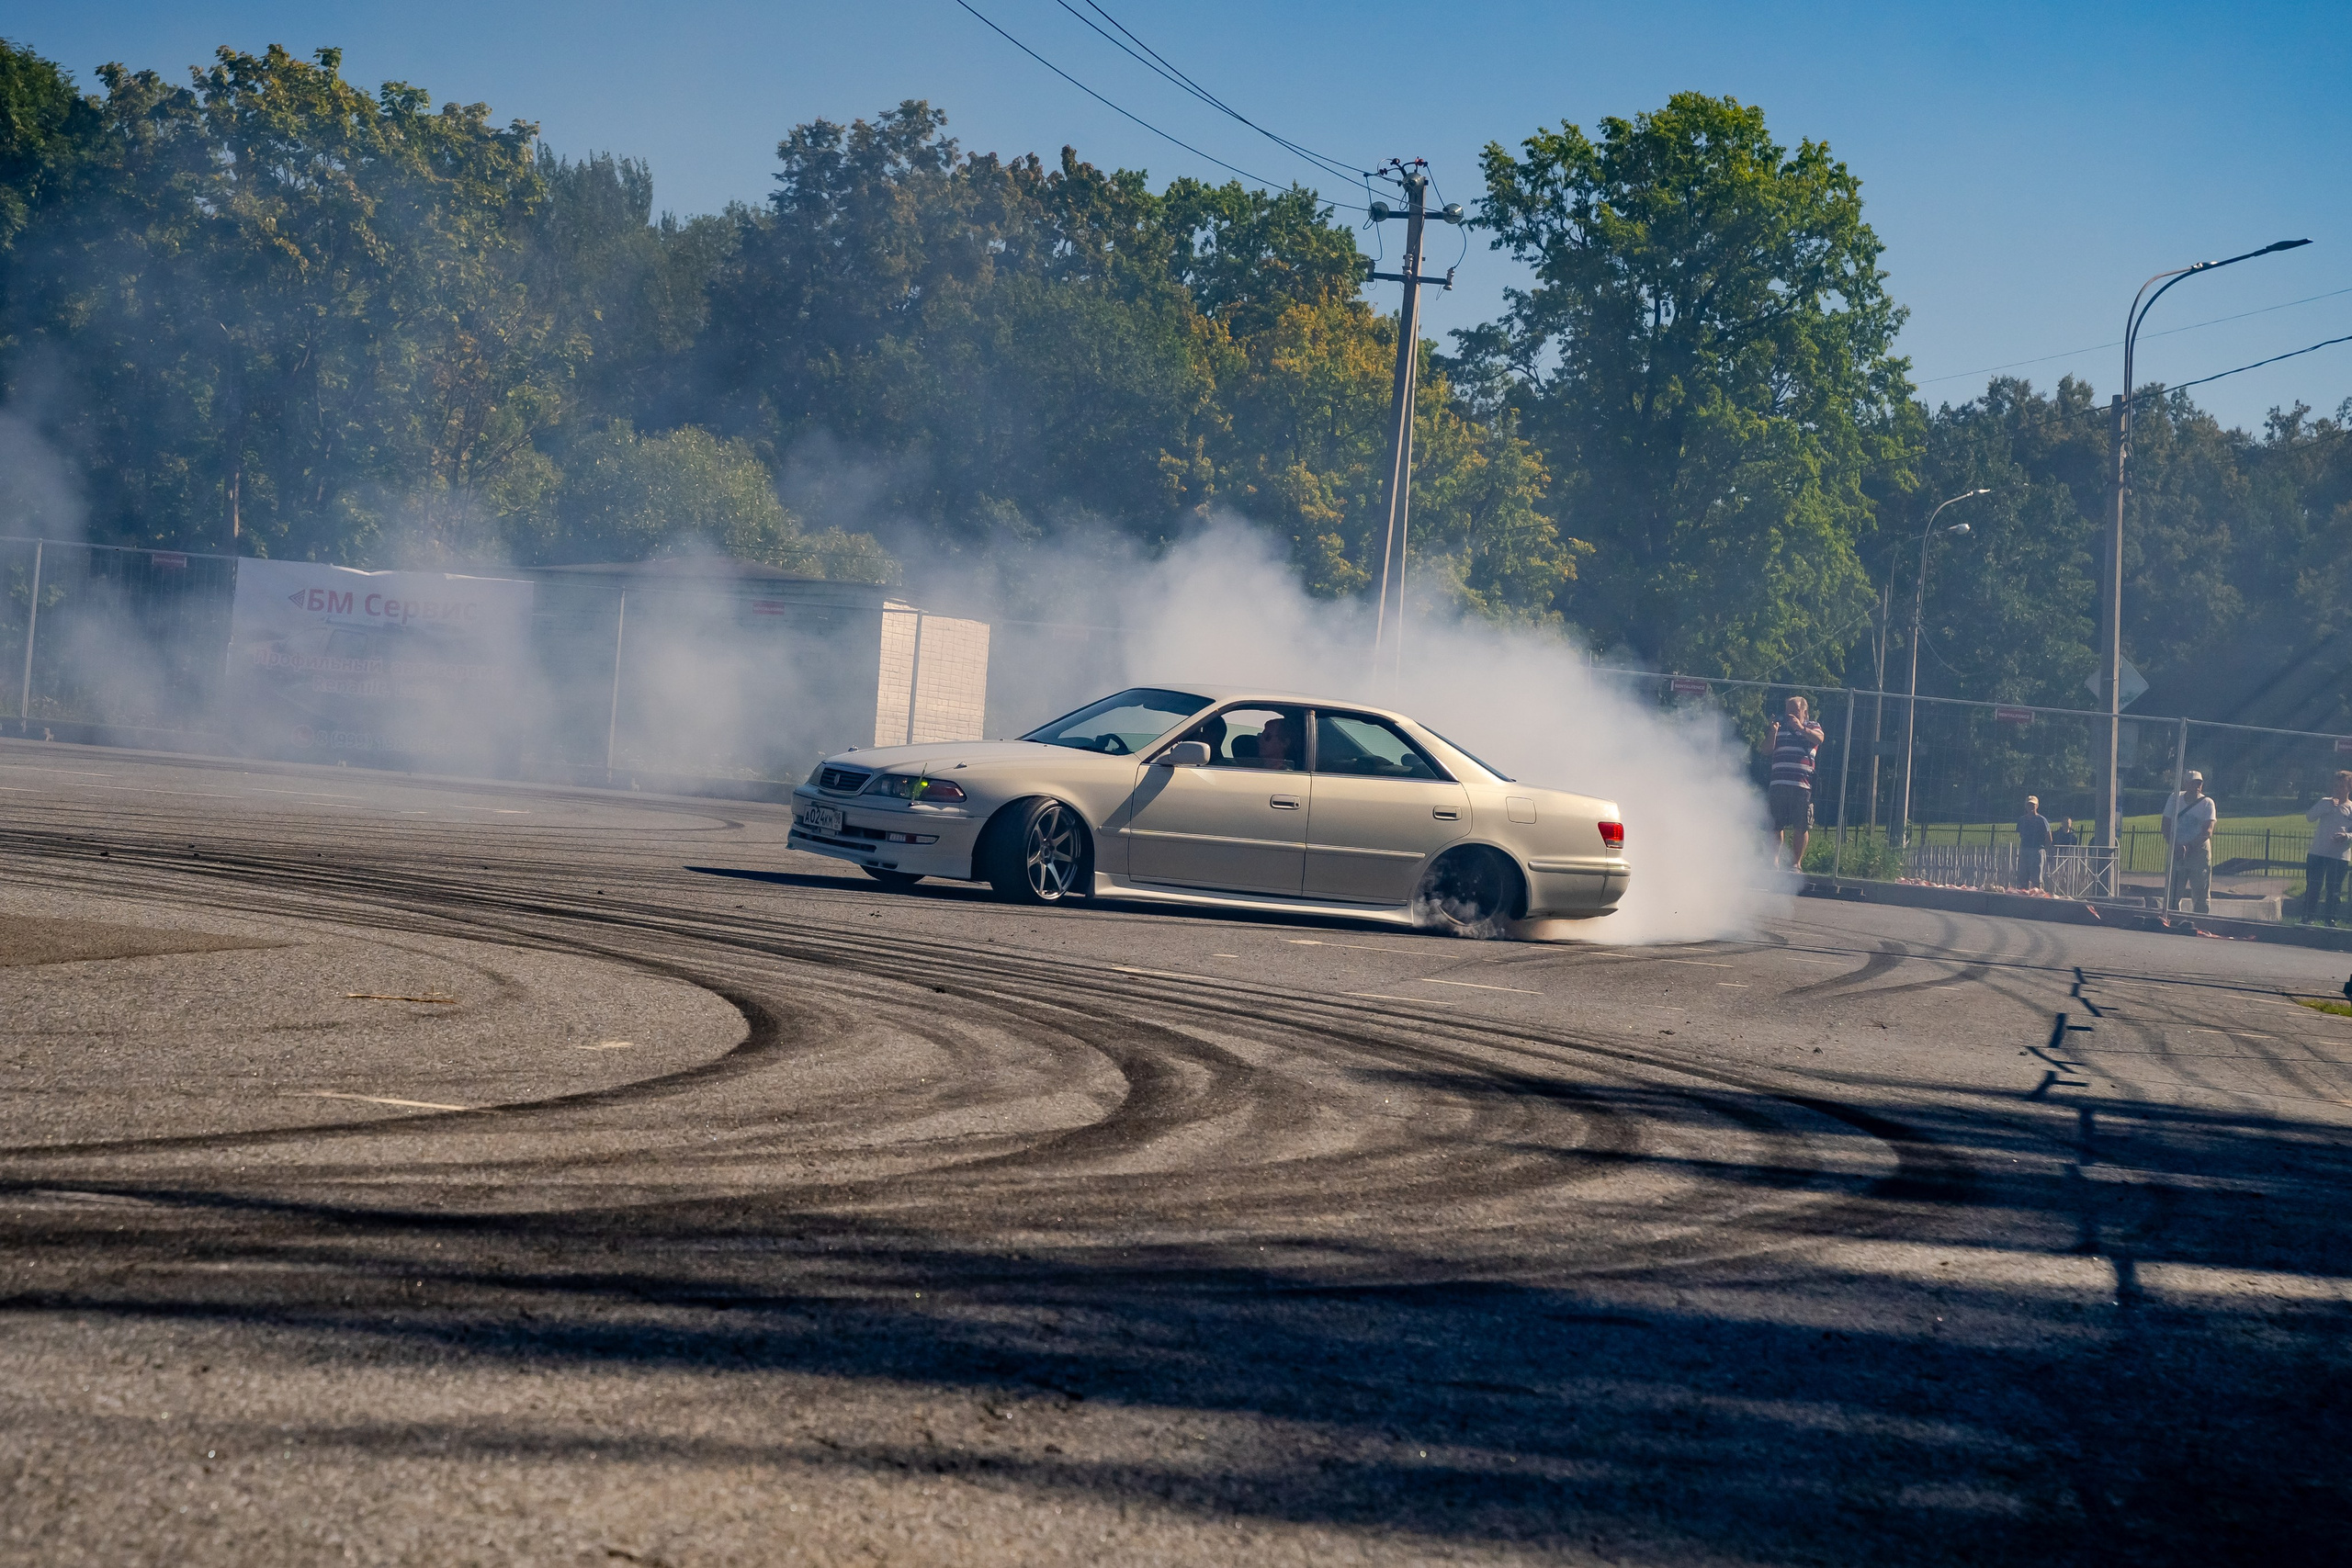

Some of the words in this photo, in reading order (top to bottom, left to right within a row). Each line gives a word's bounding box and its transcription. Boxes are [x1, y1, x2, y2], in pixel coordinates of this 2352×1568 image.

[307, 589, 354, 615] БМ
[365, 593, 478, 625] Сервис
[254, 648, 383, 673] Профильный
